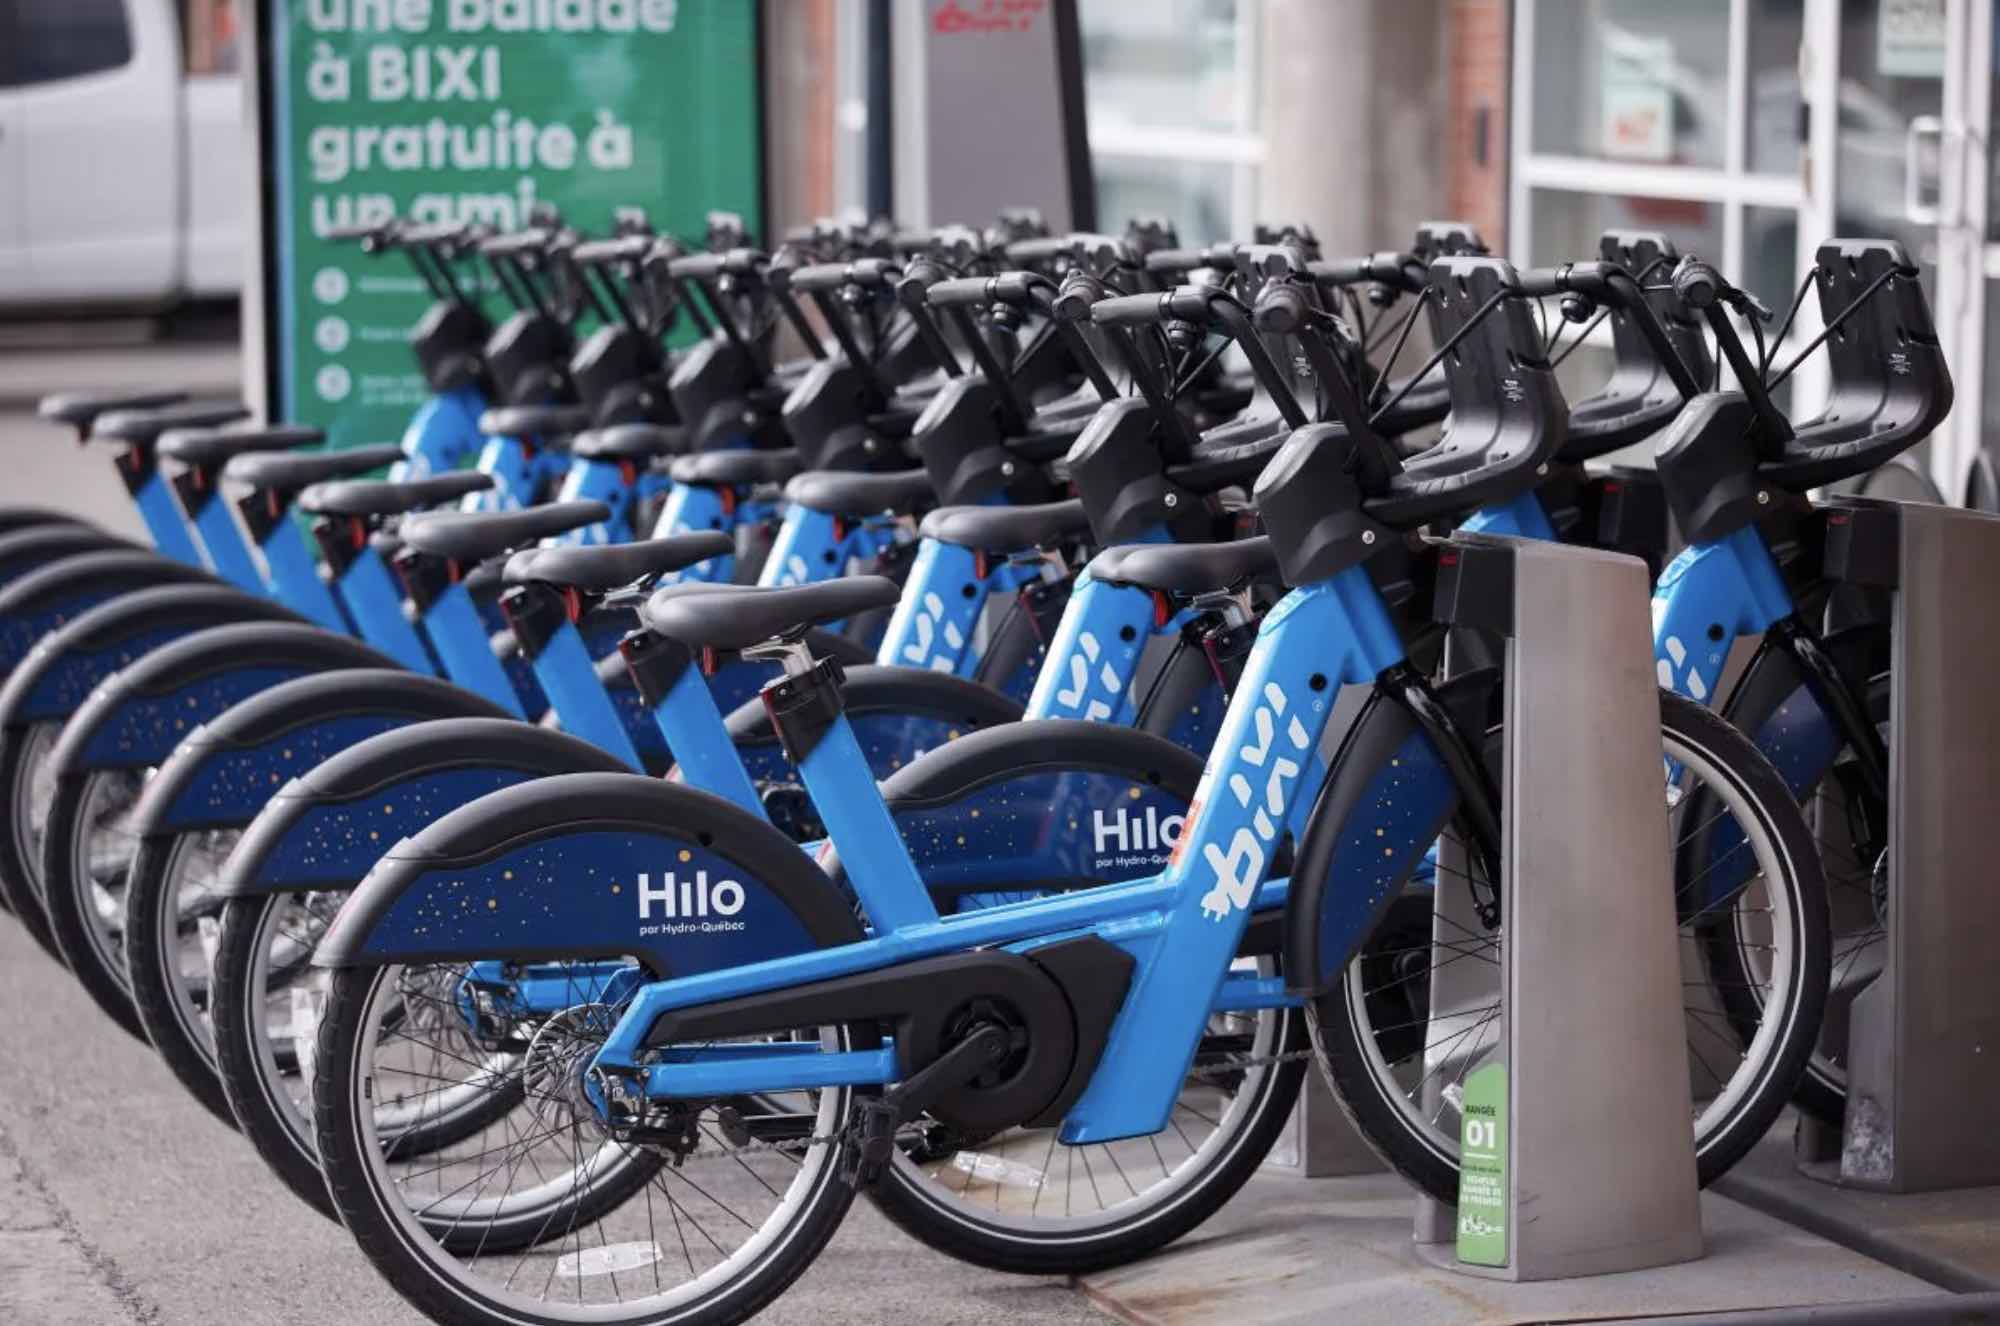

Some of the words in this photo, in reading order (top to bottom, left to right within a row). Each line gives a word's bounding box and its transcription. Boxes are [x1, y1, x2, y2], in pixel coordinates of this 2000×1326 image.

[309, 0, 431, 32] une
[448, 0, 678, 32] balade
[307, 40, 350, 99] à
[367, 46, 500, 99] BIXI
[309, 109, 577, 182] gratuite
[588, 108, 634, 170] à
[1093, 806, 1187, 853] Hilo
[1115, 854, 1170, 869] Hydro-Qu
[638, 870, 745, 919] Hilo
[639, 925, 659, 937] par
[661, 920, 745, 936] Hydro-Québec
[1466, 1119, 1496, 1149] 01
